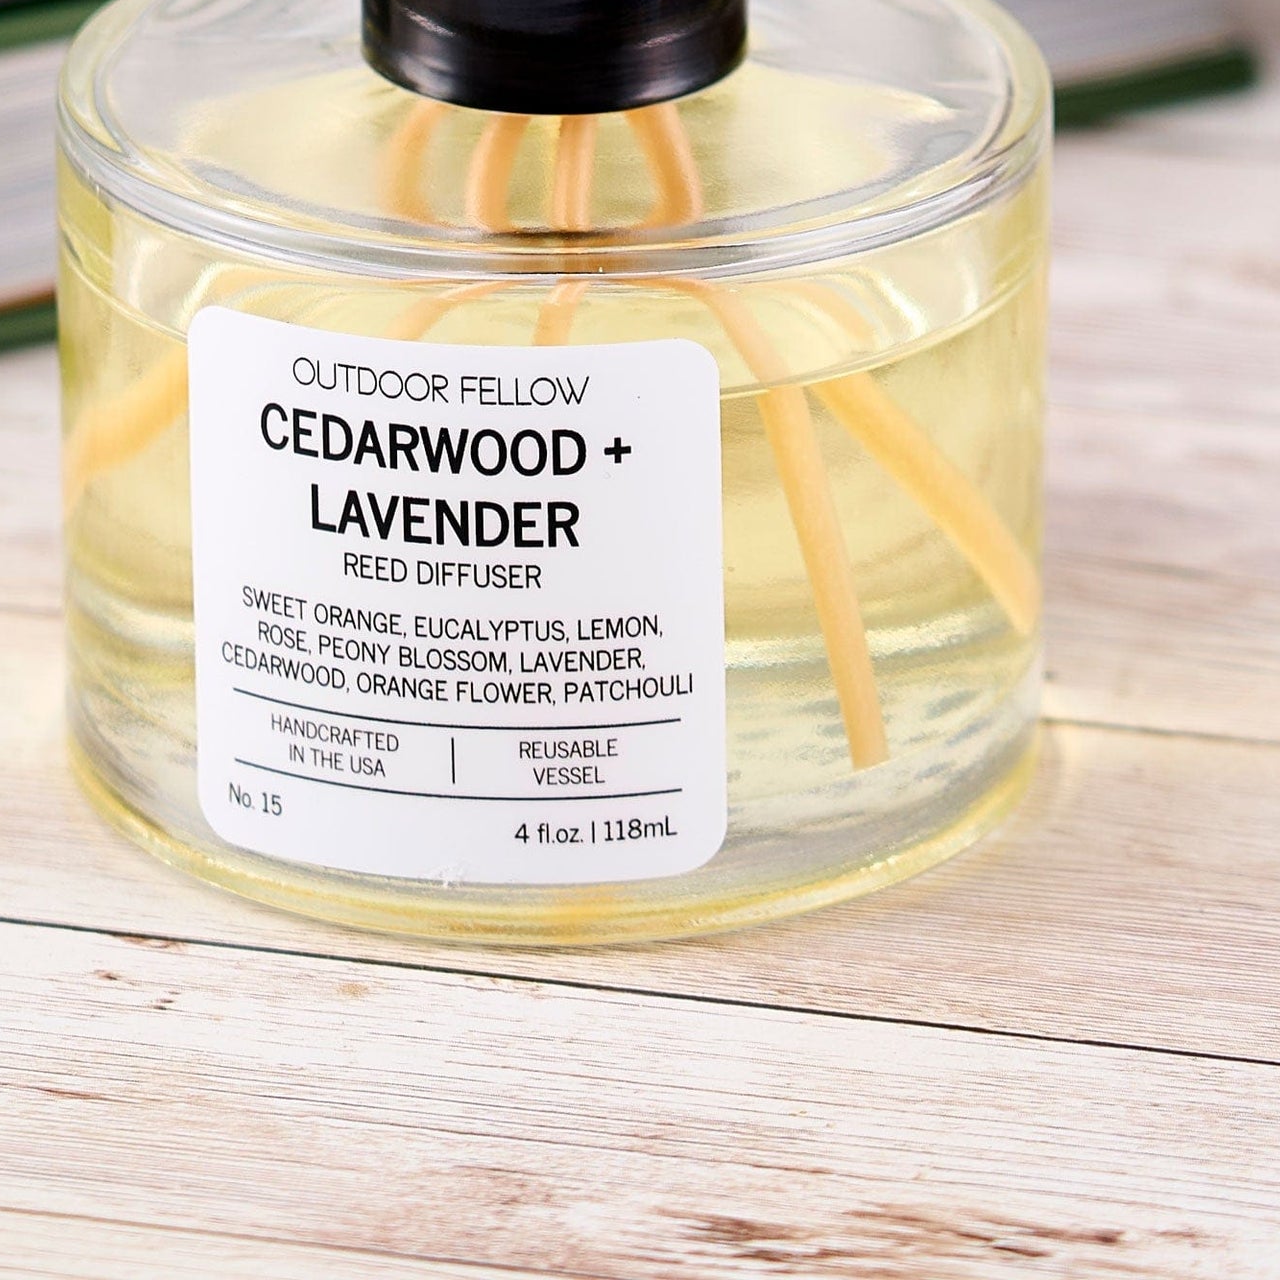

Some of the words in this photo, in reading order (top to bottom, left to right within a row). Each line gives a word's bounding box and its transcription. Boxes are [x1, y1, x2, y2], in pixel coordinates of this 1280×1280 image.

[292, 356, 450, 404] OUTDOOR
[460, 375, 590, 407] FELLOW
[260, 402, 588, 478] CEDARWOOD
[310, 482, 580, 549] LAVENDER
[343, 551, 408, 583] REED
[416, 559, 542, 590] DIFFUSER
[242, 585, 308, 621] SWEET
[313, 602, 407, 640] ORANGE,
[414, 615, 570, 645] EUCALYPTUS,
[577, 613, 663, 642] LEMON,
[257, 619, 312, 656] ROSE,
[318, 633, 392, 666] PEONY
[398, 644, 513, 677] BLOSSOM,
[520, 646, 646, 674] LAVENDER,
[221, 640, 350, 694] CEDARWOOD,
[356, 671, 449, 702] ORANGE
[455, 680, 557, 707] FLOWER,
[563, 672, 694, 704] PATCHOULI
[271, 713, 400, 753] HANDCRAFTED
[518, 737, 619, 760] REUSABLE
[289, 743, 305, 764] IN
[309, 747, 345, 772] THE
[349, 754, 386, 778] USA
[532, 765, 606, 786] VESSEL
[229, 782, 255, 809] No.
[261, 791, 283, 817] 15
[513, 822, 531, 845] 4
[603, 814, 679, 842] 118mL
